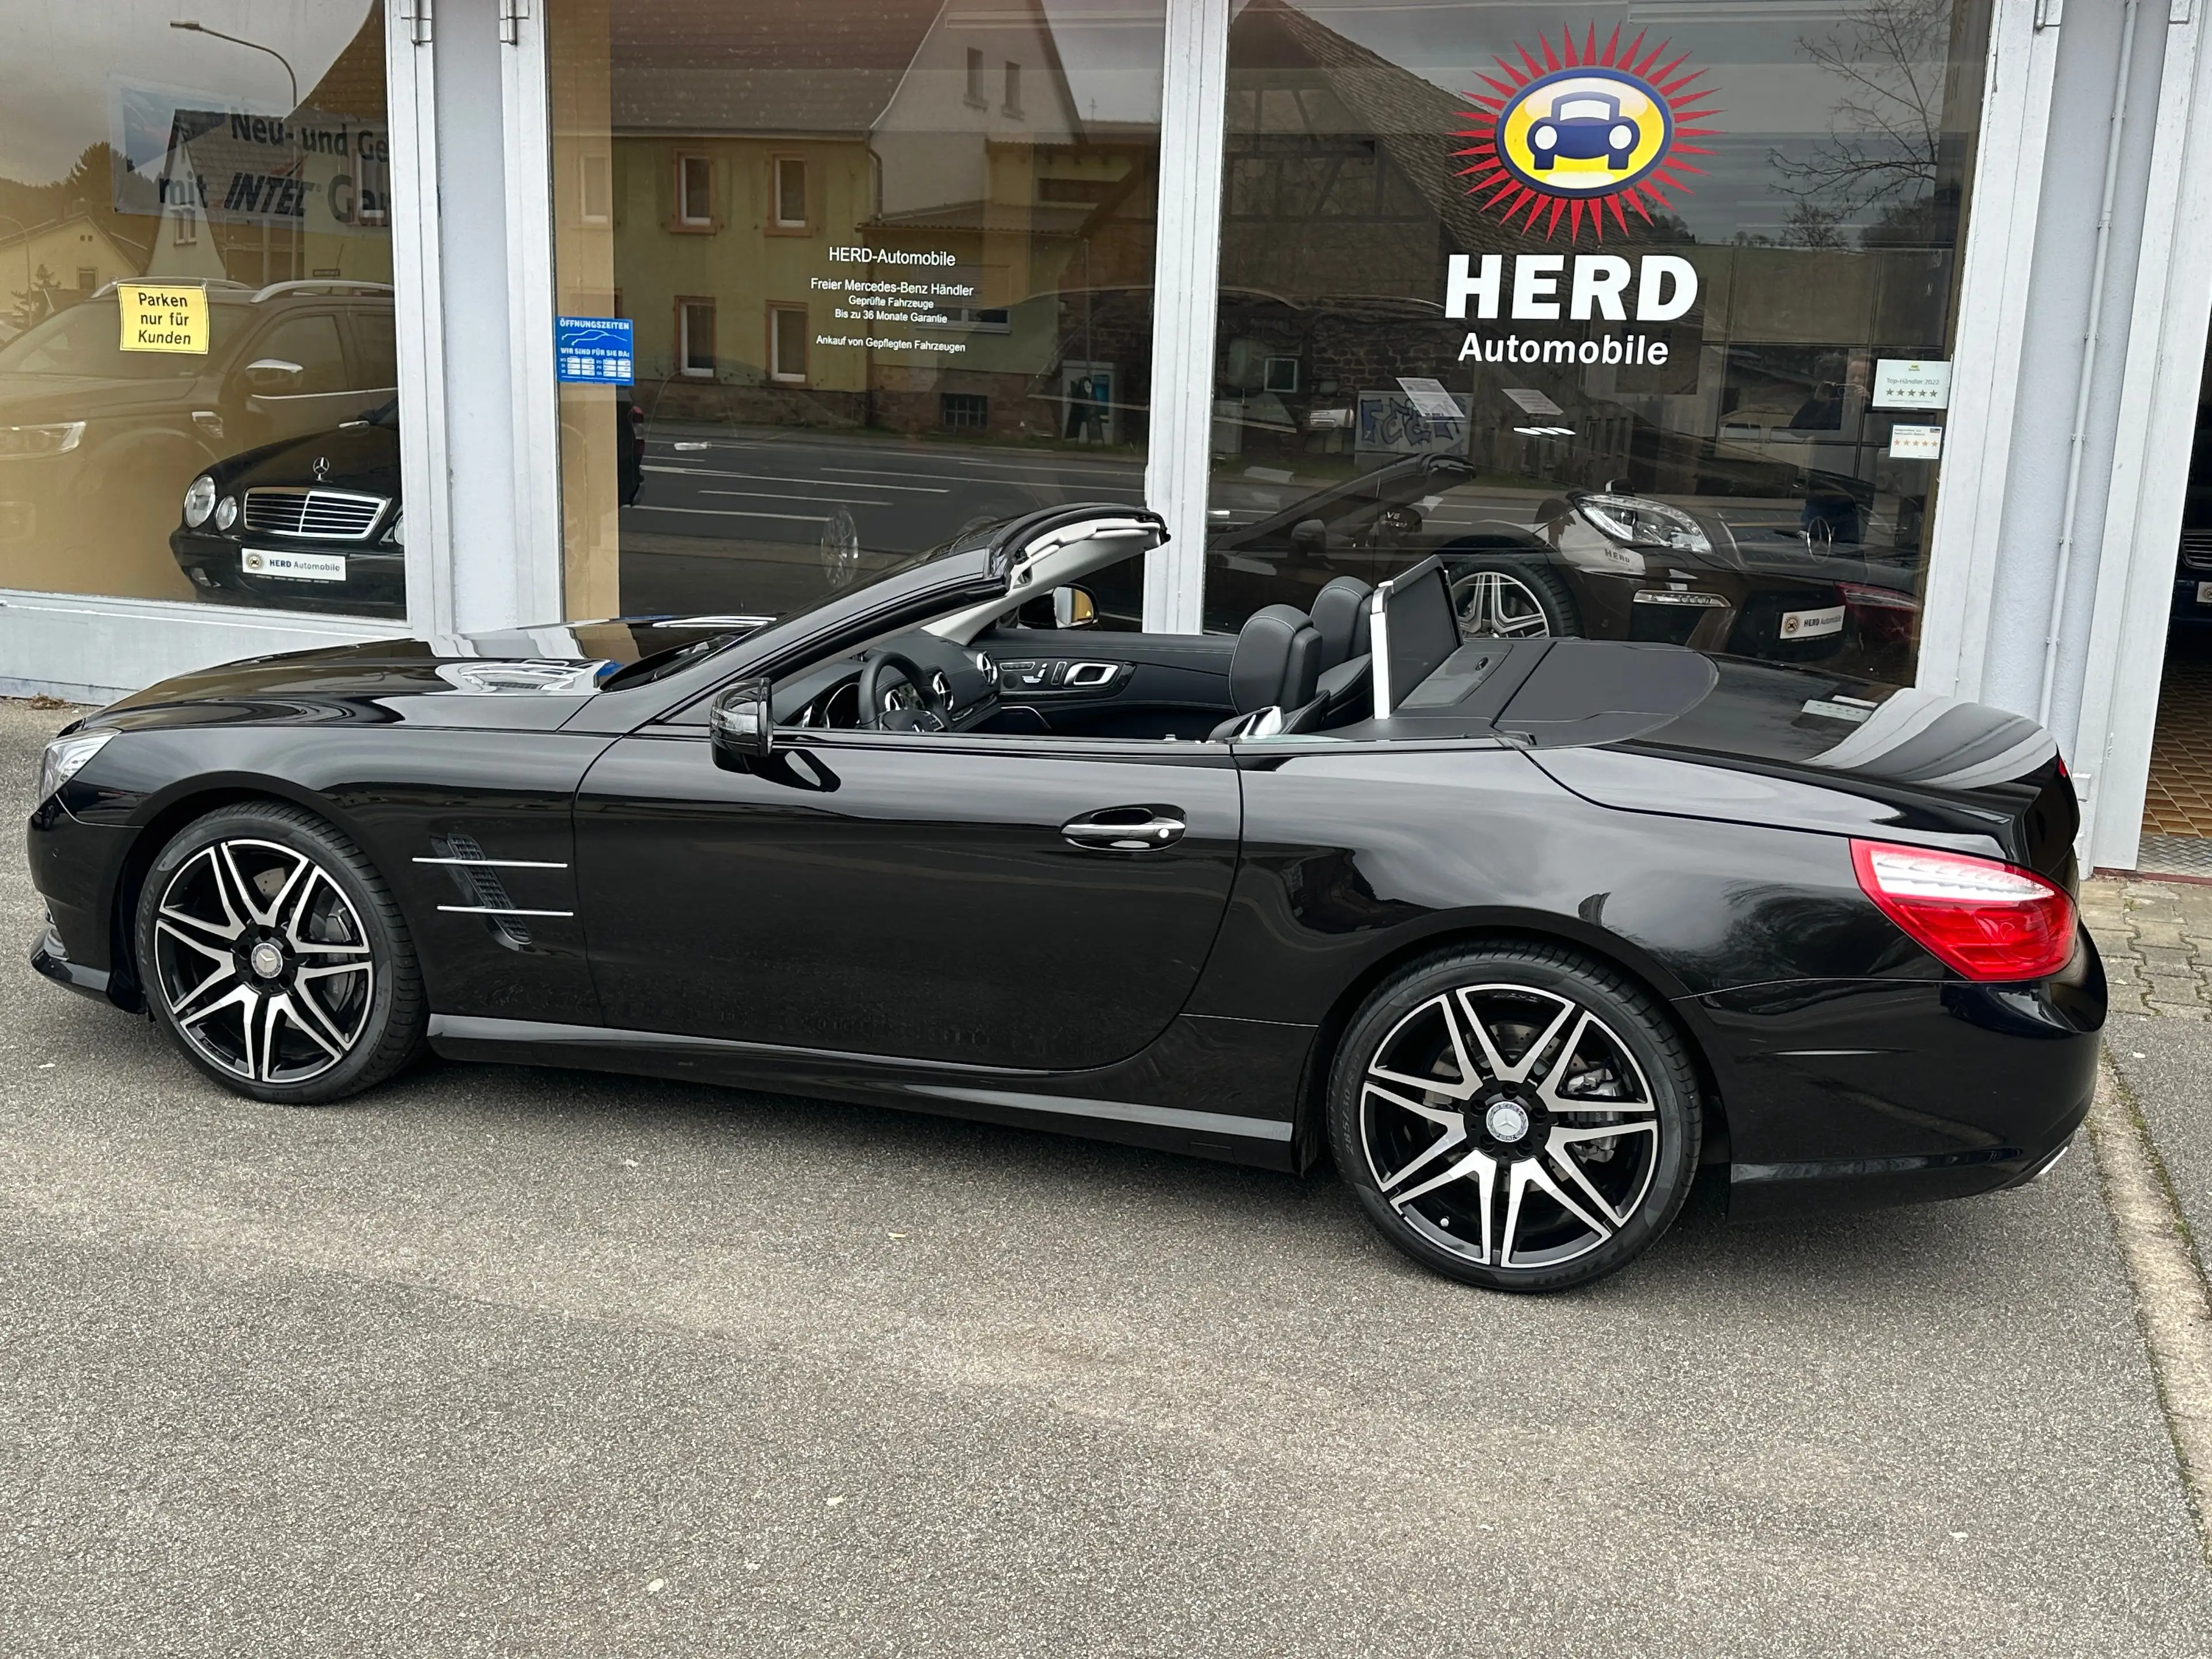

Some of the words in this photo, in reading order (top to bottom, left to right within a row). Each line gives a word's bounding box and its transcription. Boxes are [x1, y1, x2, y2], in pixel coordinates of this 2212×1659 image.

[231, 108, 293, 145] Neu-
[302, 124, 348, 157] und
[159, 171, 208, 208] mit
[829, 247, 956, 266] HERD-Automobile
[810, 278, 842, 290] Freier
[844, 279, 928, 295] Mercedes-Benz
[931, 283, 974, 296] Händler
[1445, 254, 1698, 320] HERD
[138, 292, 188, 307] Parken
[848, 296, 885, 307] Geprüfte
[888, 297, 934, 310] Fahrzeuge
[141, 315, 162, 325] nur
[169, 312, 189, 326] für
[560, 318, 630, 329] ÖFFNUNGSZEITEN
[835, 309, 849, 319] Bis
[863, 310, 874, 320] 36
[876, 311, 908, 321] Monate
[910, 313, 948, 323] Garantie
[138, 329, 191, 345] Kunden
[816, 335, 847, 346] Ankauf
[848, 338, 863, 346] von
[865, 337, 912, 351] Gepflegten
[914, 340, 965, 354] Fahrzeugen
[592, 347, 605, 355] FÜR
[1458, 332, 1669, 365] Automobile
[270, 559, 291, 568] HERD
[294, 561, 340, 571] Automobile
